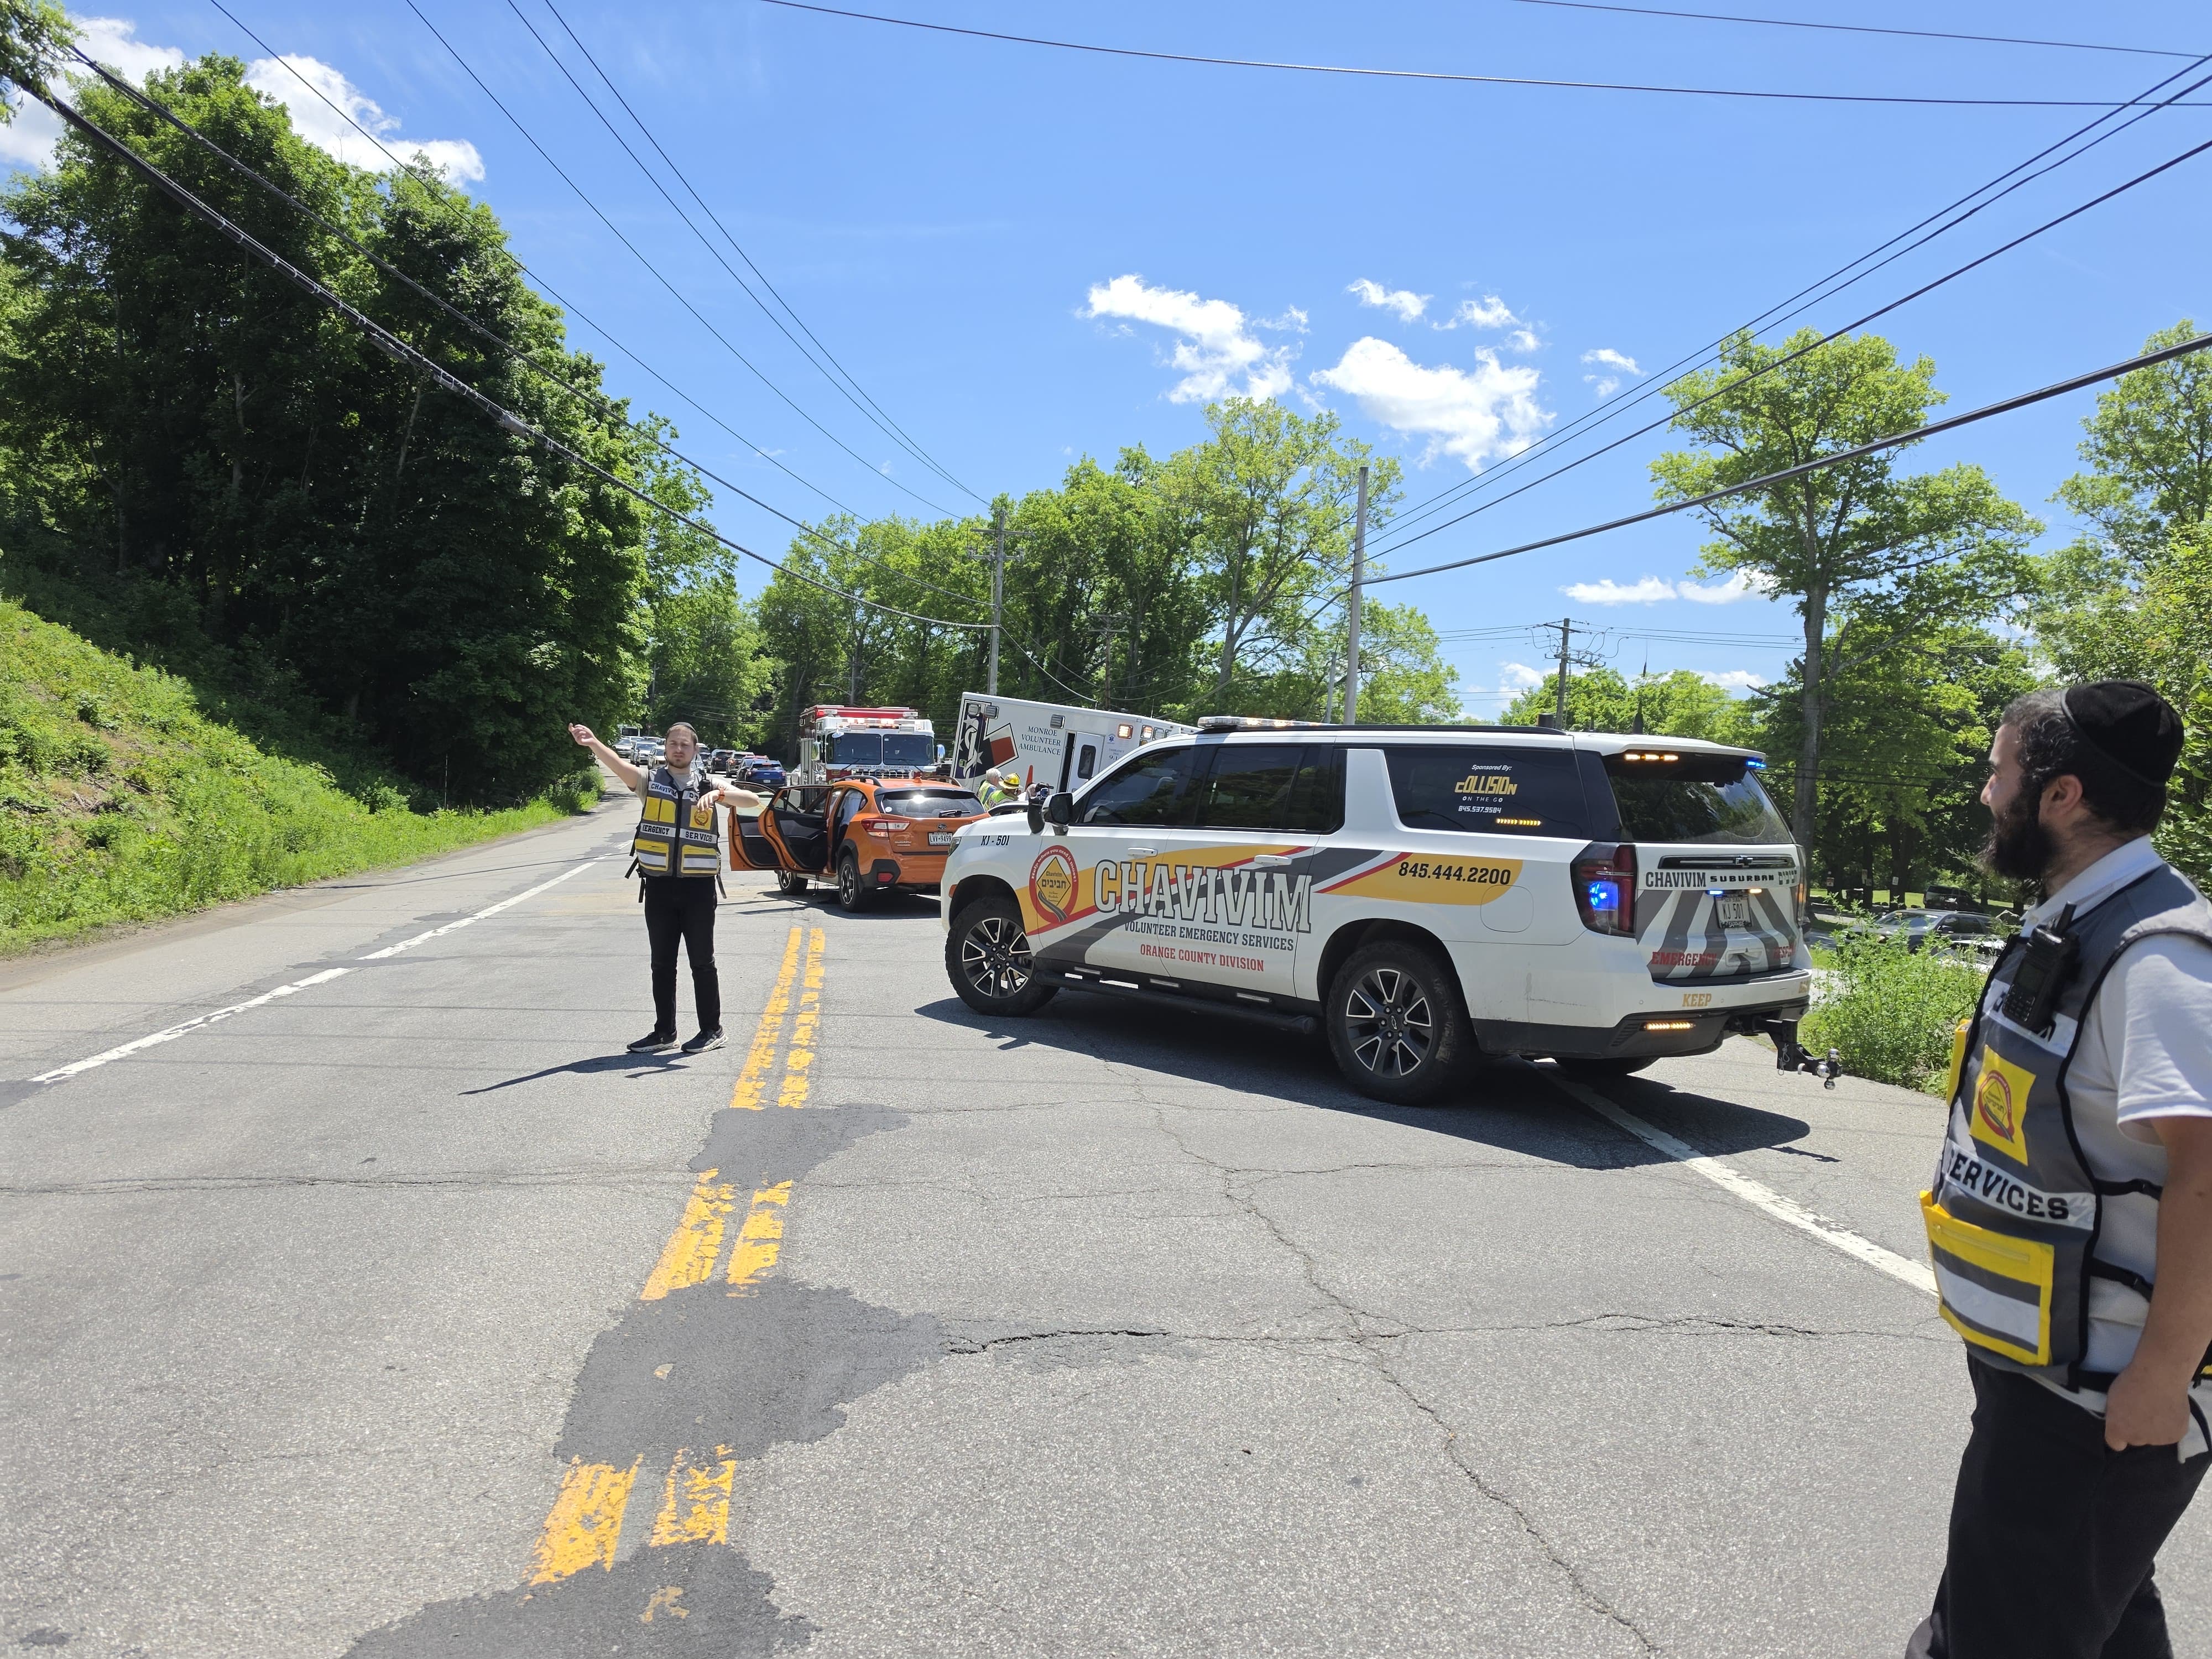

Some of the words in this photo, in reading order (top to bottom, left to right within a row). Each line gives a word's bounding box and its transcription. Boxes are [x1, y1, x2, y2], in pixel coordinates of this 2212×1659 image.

[1027, 726, 1057, 736] MONROE
[1021, 734, 1061, 746] VOLUNTEER
[1018, 743, 1061, 755] AMBULANCE
[1458, 805, 1502, 813] 845.537.9584
[981, 836, 990, 846] KJ
[995, 836, 1010, 846] 501
[1399, 862, 1511, 885] 845.444.2200
[1645, 872, 1706, 888] CHAVIVIM
[1042, 879, 1067, 889] חביבים
[1094, 859, 1312, 933] CHAVIVIM
[1124, 921, 1176, 937] VOLUNTEER
[1179, 926, 1239, 945] EMERGENCY
[1241, 933, 1294, 951] SERVICES
[1140, 943, 1176, 959] ORANGE
[1178, 949, 1217, 964] COUNTY
[1219, 954, 1264, 972] DIVISION
[1651, 951, 1717, 966] EMERGENCY
[1682, 993, 1712, 1007] KEEP
